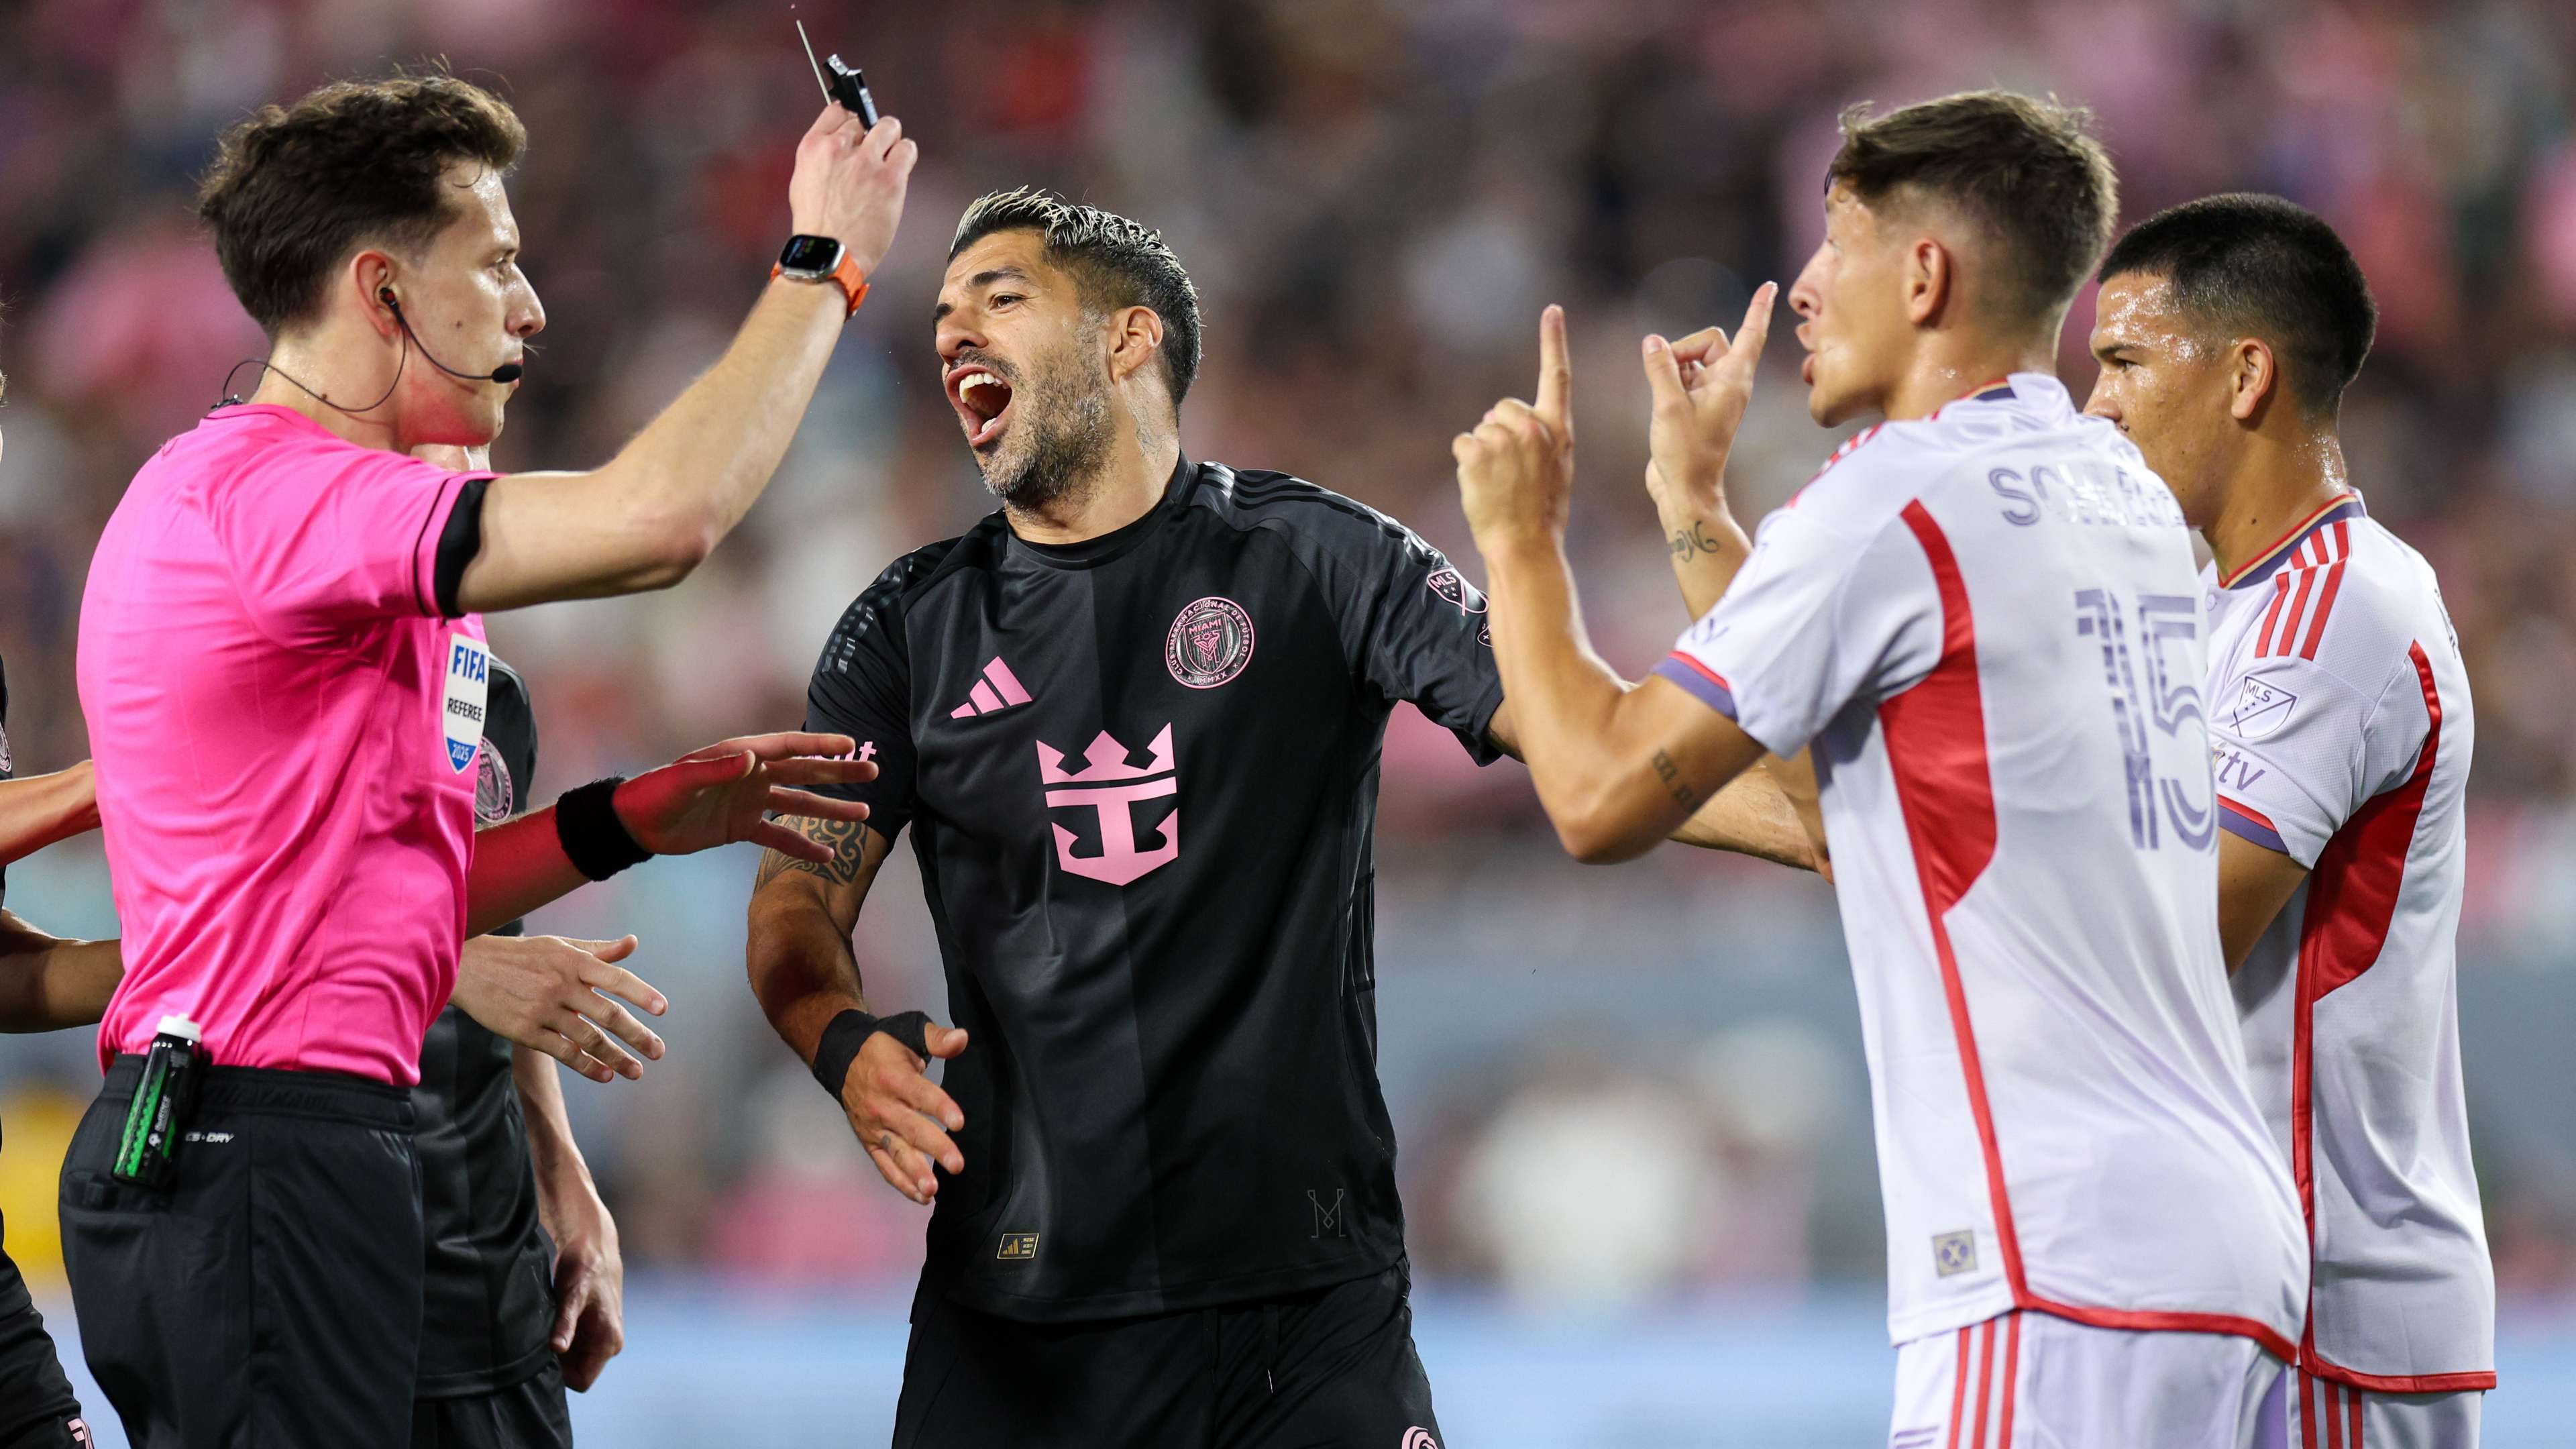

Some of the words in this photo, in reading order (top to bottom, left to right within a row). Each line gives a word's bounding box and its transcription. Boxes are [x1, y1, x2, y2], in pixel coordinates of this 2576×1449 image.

[1430, 573, 1456, 588] MLS
[1169, 600, 1230, 651] NTERNACIONAL
[1232, 609, 1242, 621] DE
[1189, 619, 1222, 635] MIAMI
[452, 645, 486, 684] FIFA
[1169, 654, 1183, 675] CLUB
[2245, 682, 2272, 702] MLS
[447, 698, 482, 722] REFEREE
[2075, 589, 2218, 853] 15
[451, 742, 470, 762] 2025
[2218, 751, 2266, 791] tv
